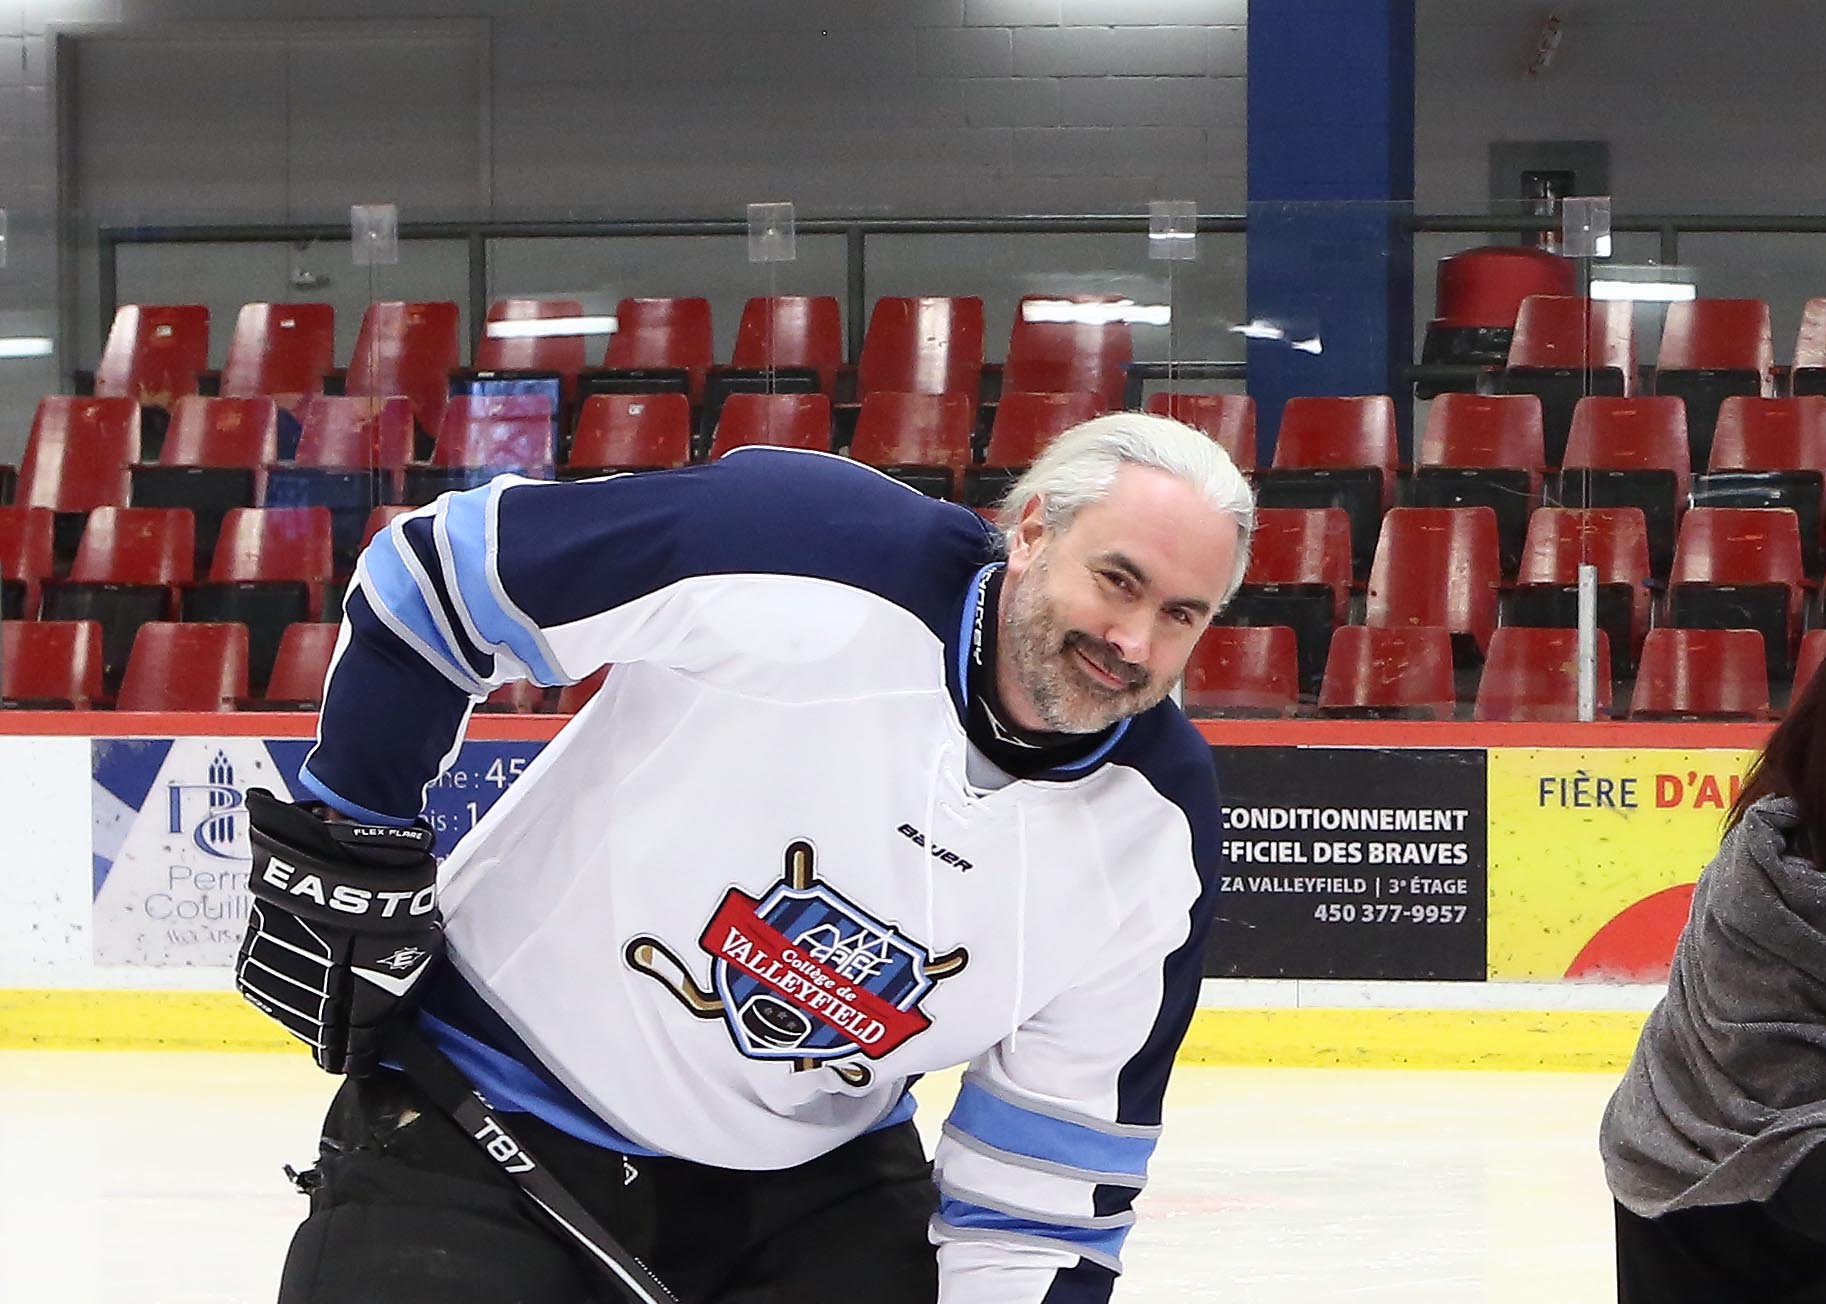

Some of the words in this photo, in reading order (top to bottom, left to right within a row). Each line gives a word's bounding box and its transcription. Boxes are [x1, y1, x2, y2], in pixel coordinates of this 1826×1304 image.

[1539, 769, 1638, 808] FIÈRE
[354, 828, 385, 838] FLEX
[389, 829, 424, 841] FLARE
[1313, 842, 1362, 864] DES
[1368, 843, 1468, 865] BRAVES
[263, 856, 436, 918] EASTO
[1248, 877, 1367, 893] VALLEYFIELD
[1410, 875, 1468, 895] ÉTAGE
[1314, 904, 1356, 923] 450
[1361, 904, 1467, 923] 377-9957
[721, 926, 885, 1044] VALLEYFIELD
[782, 949, 836, 989] Collège
[836, 984, 858, 1002] de
[474, 1116, 536, 1173] T87
